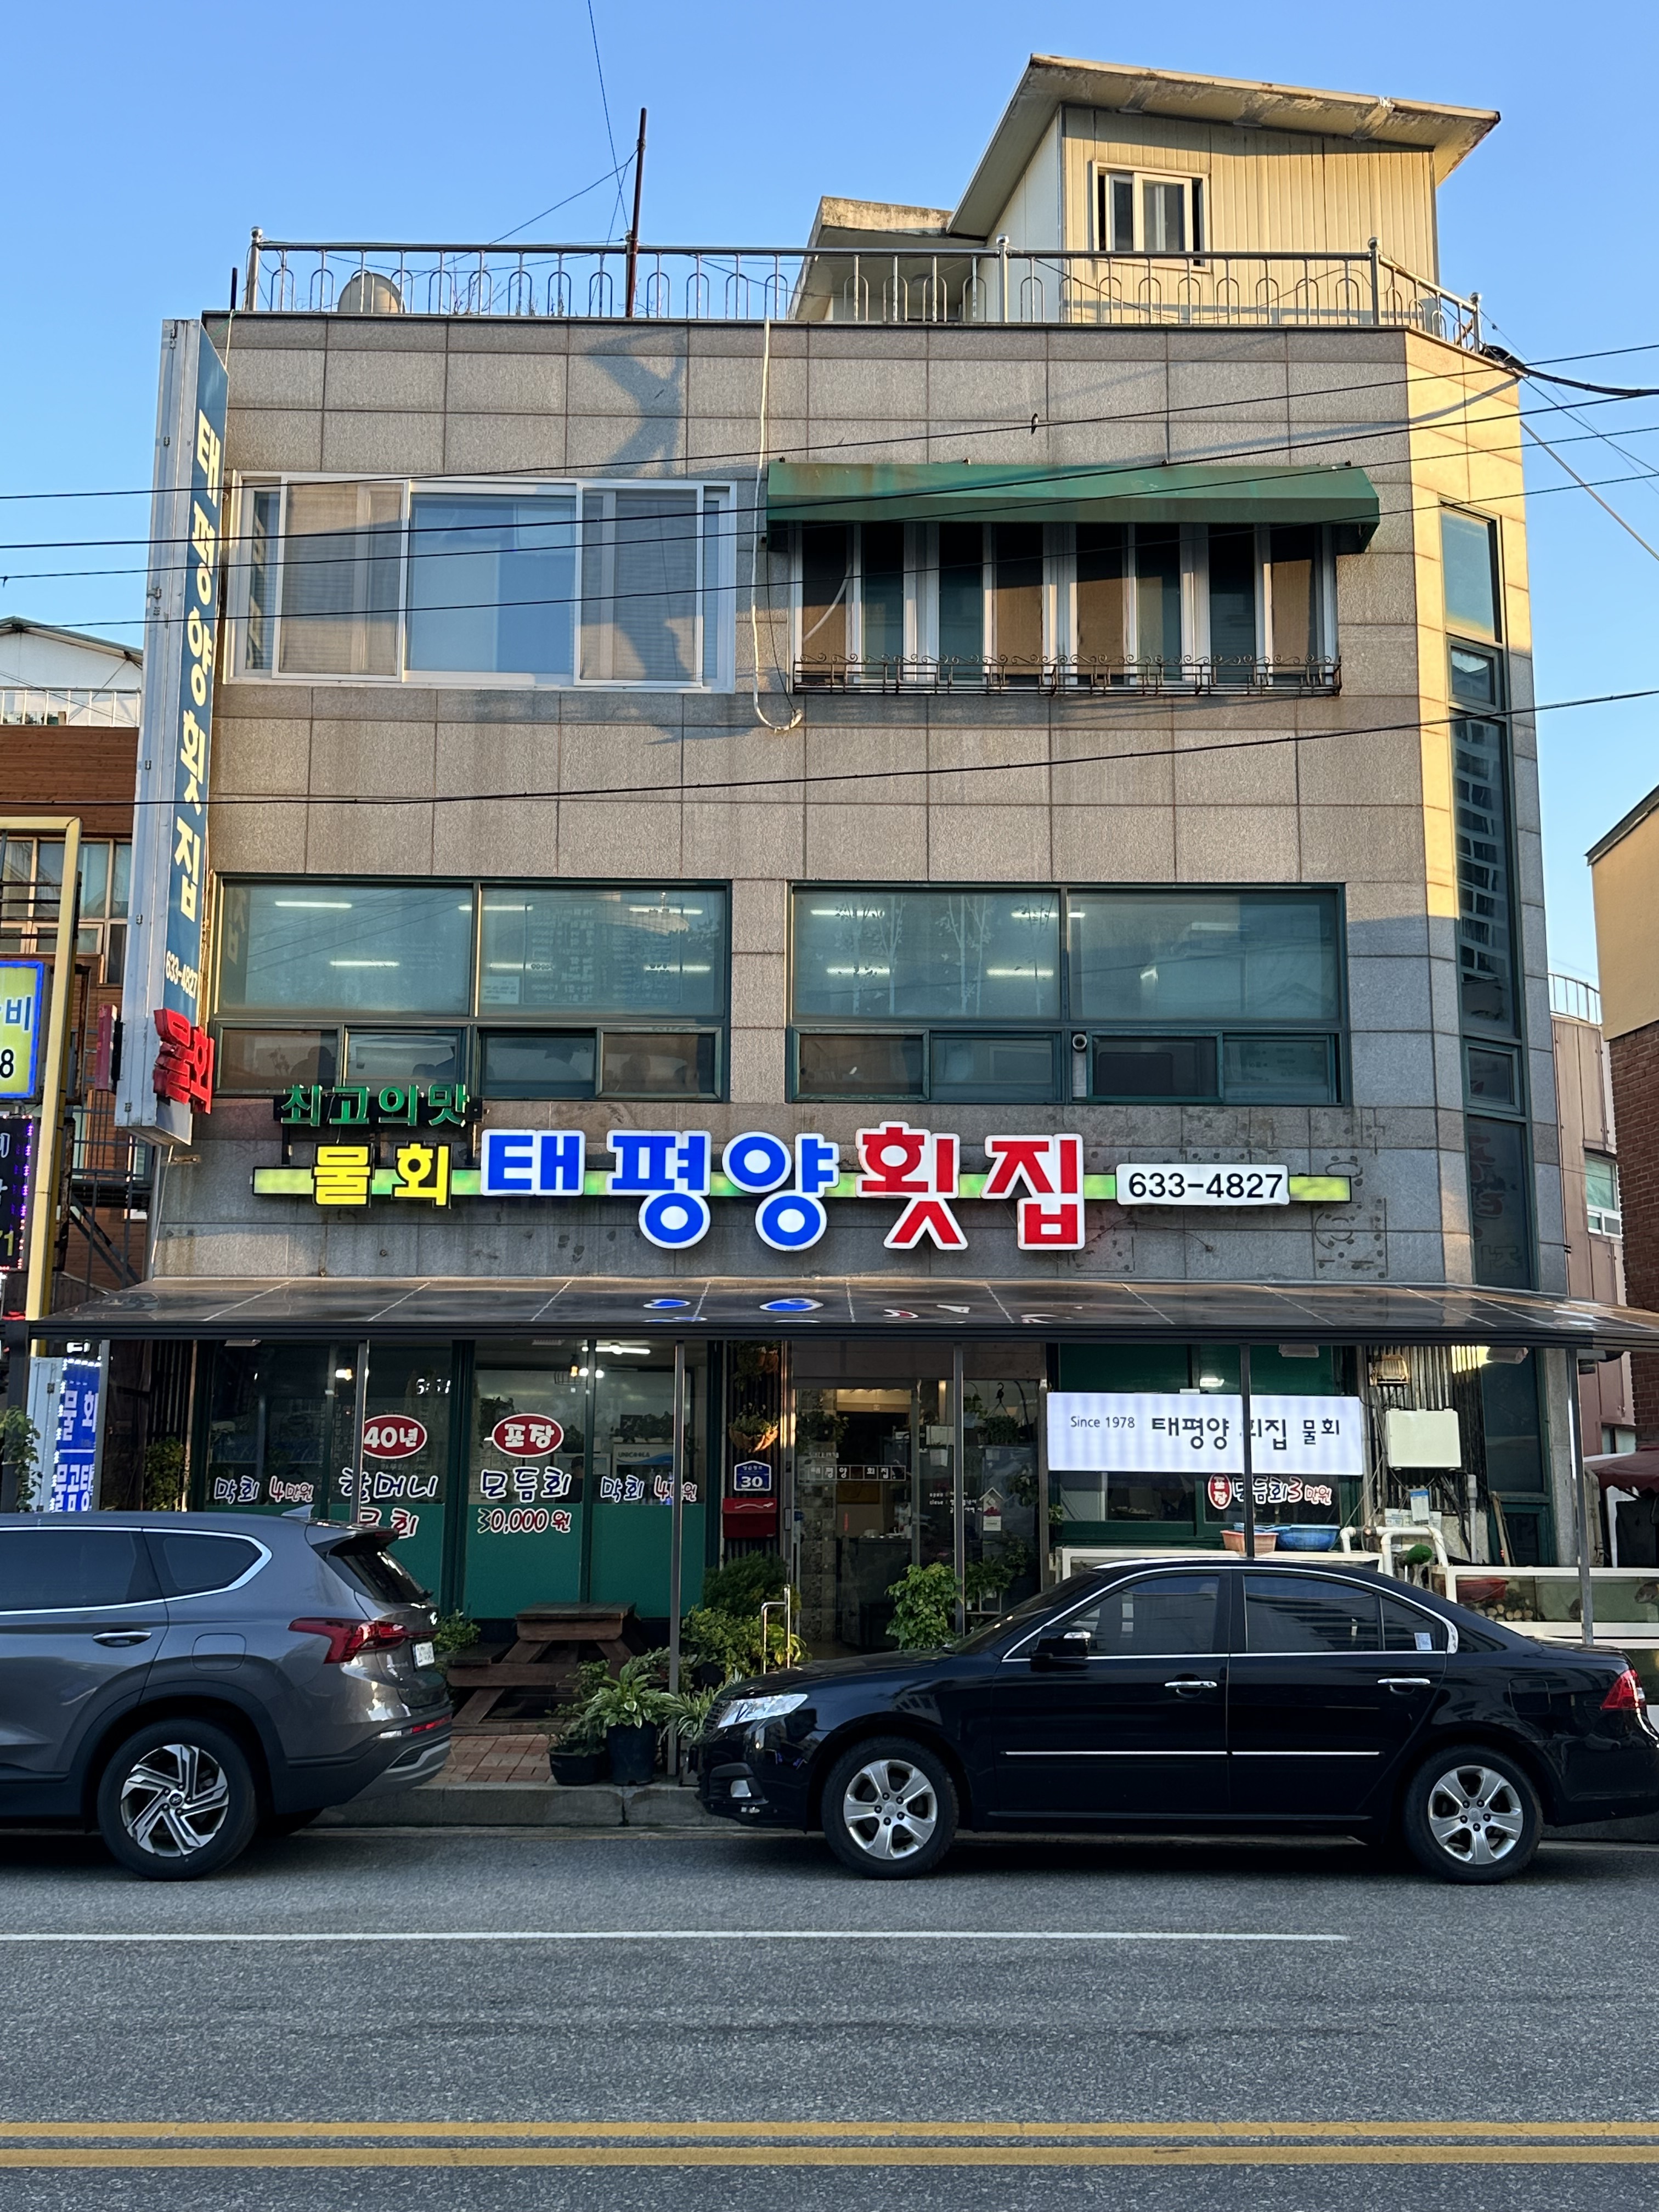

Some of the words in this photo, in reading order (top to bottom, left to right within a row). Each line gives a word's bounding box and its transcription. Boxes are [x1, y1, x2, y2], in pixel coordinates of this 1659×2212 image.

[174, 408, 221, 923] 태평양횟집
[166, 950, 198, 999] 633-4827
[0, 995, 32, 1031] 비
[156, 1008, 215, 1115] 물회
[313, 1142, 450, 1207] 물회
[482, 1122, 1085, 1251] 태평양횟집
[1128, 1173, 1284, 1200] 633-4827
[62, 1390, 100, 1442] 물회
[1070, 1415, 1101, 1428] Since
[1105, 1417, 1135, 1429] 1978
[1152, 1417, 1229, 1450] 태평양
[1302, 1418, 1340, 1445] 물회
[364, 1426, 419, 1448] 40년
[504, 1423, 555, 1448] 포장
[215, 1476, 259, 1504] 막회
[269, 1476, 314, 1503] 4만원
[481, 1466, 572, 1503] 모듬회
[600, 1474, 645, 1503] 막회
[654, 1475, 698, 1503] 4원
[741, 1476, 763, 1488] 30
